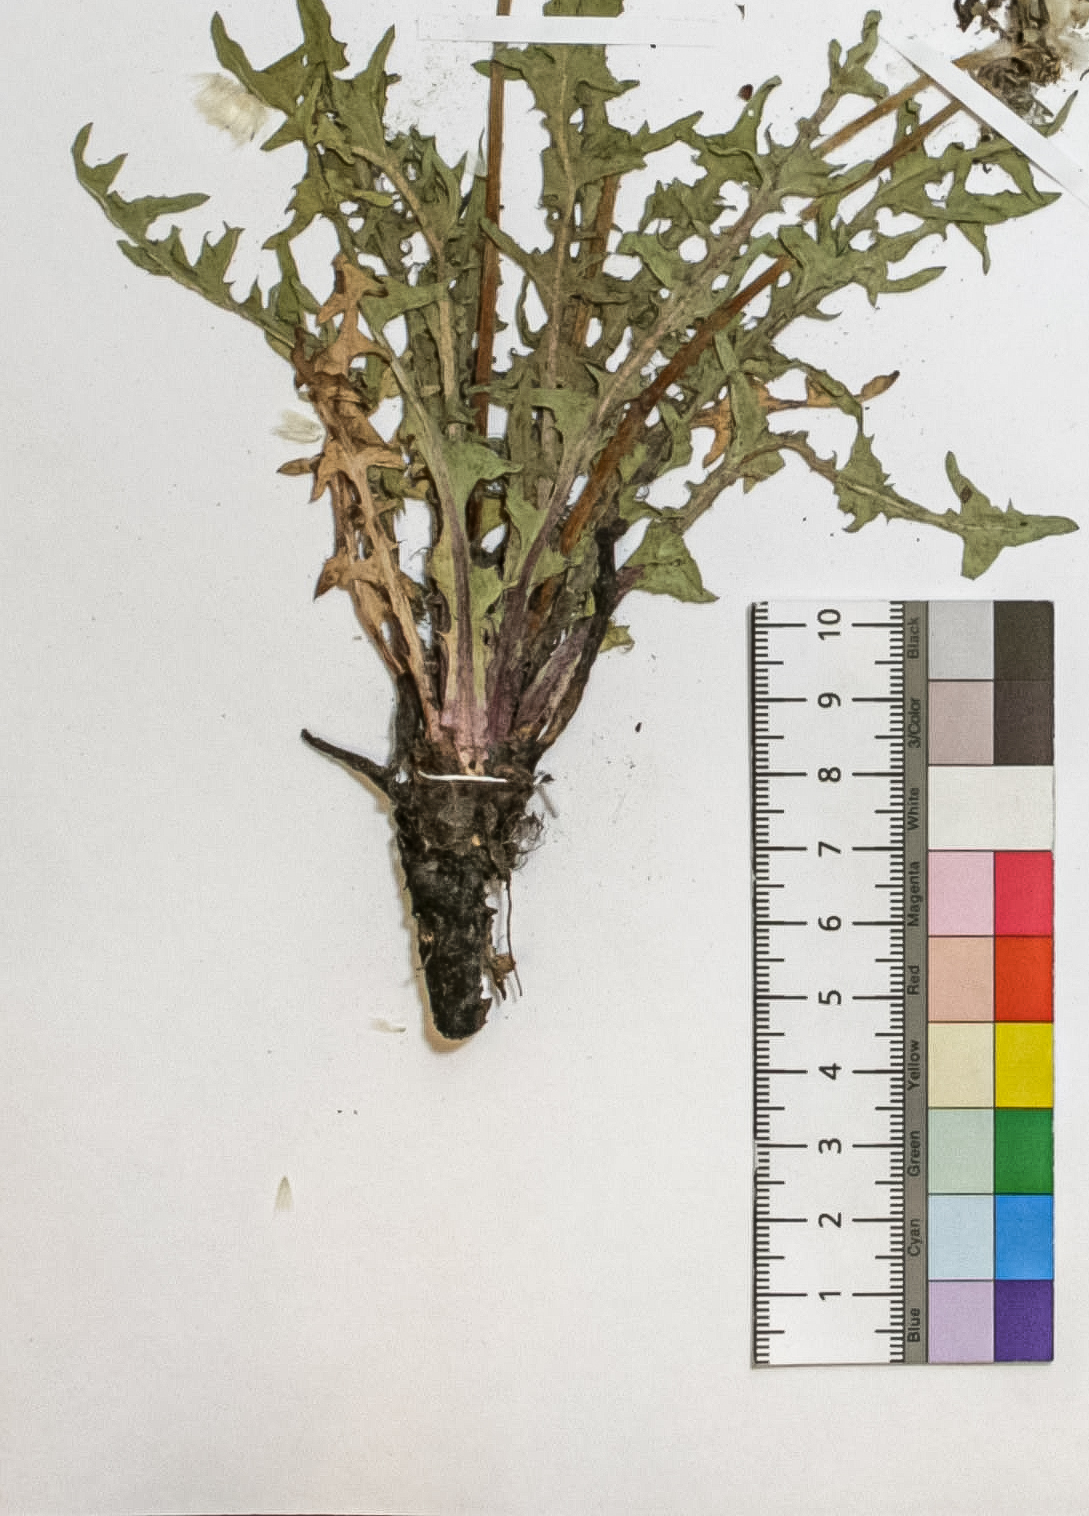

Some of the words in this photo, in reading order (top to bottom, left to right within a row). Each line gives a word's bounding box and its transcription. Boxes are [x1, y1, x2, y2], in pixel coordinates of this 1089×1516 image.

[817, 608, 841, 641] 10
[907, 616, 920, 660] Black
[817, 692, 841, 709] 9
[907, 696, 922, 750] 3/Color
[817, 766, 841, 783] 8
[907, 787, 920, 831] White
[817, 841, 841, 857] 7
[907, 860, 923, 928] Magenta
[817, 915, 841, 932] 6
[907, 964, 920, 996] Red
[817, 989, 842, 1006] 5
[817, 1062, 842, 1080] 4
[907, 1039, 920, 1092] Yellow
[817, 1138, 842, 1154] 3
[907, 1129, 920, 1178] Green
[817, 1212, 842, 1228] 2
[907, 1218, 922, 1257] Cyan
[817, 1291, 842, 1301] 1
[907, 1307, 920, 1343] Blue
